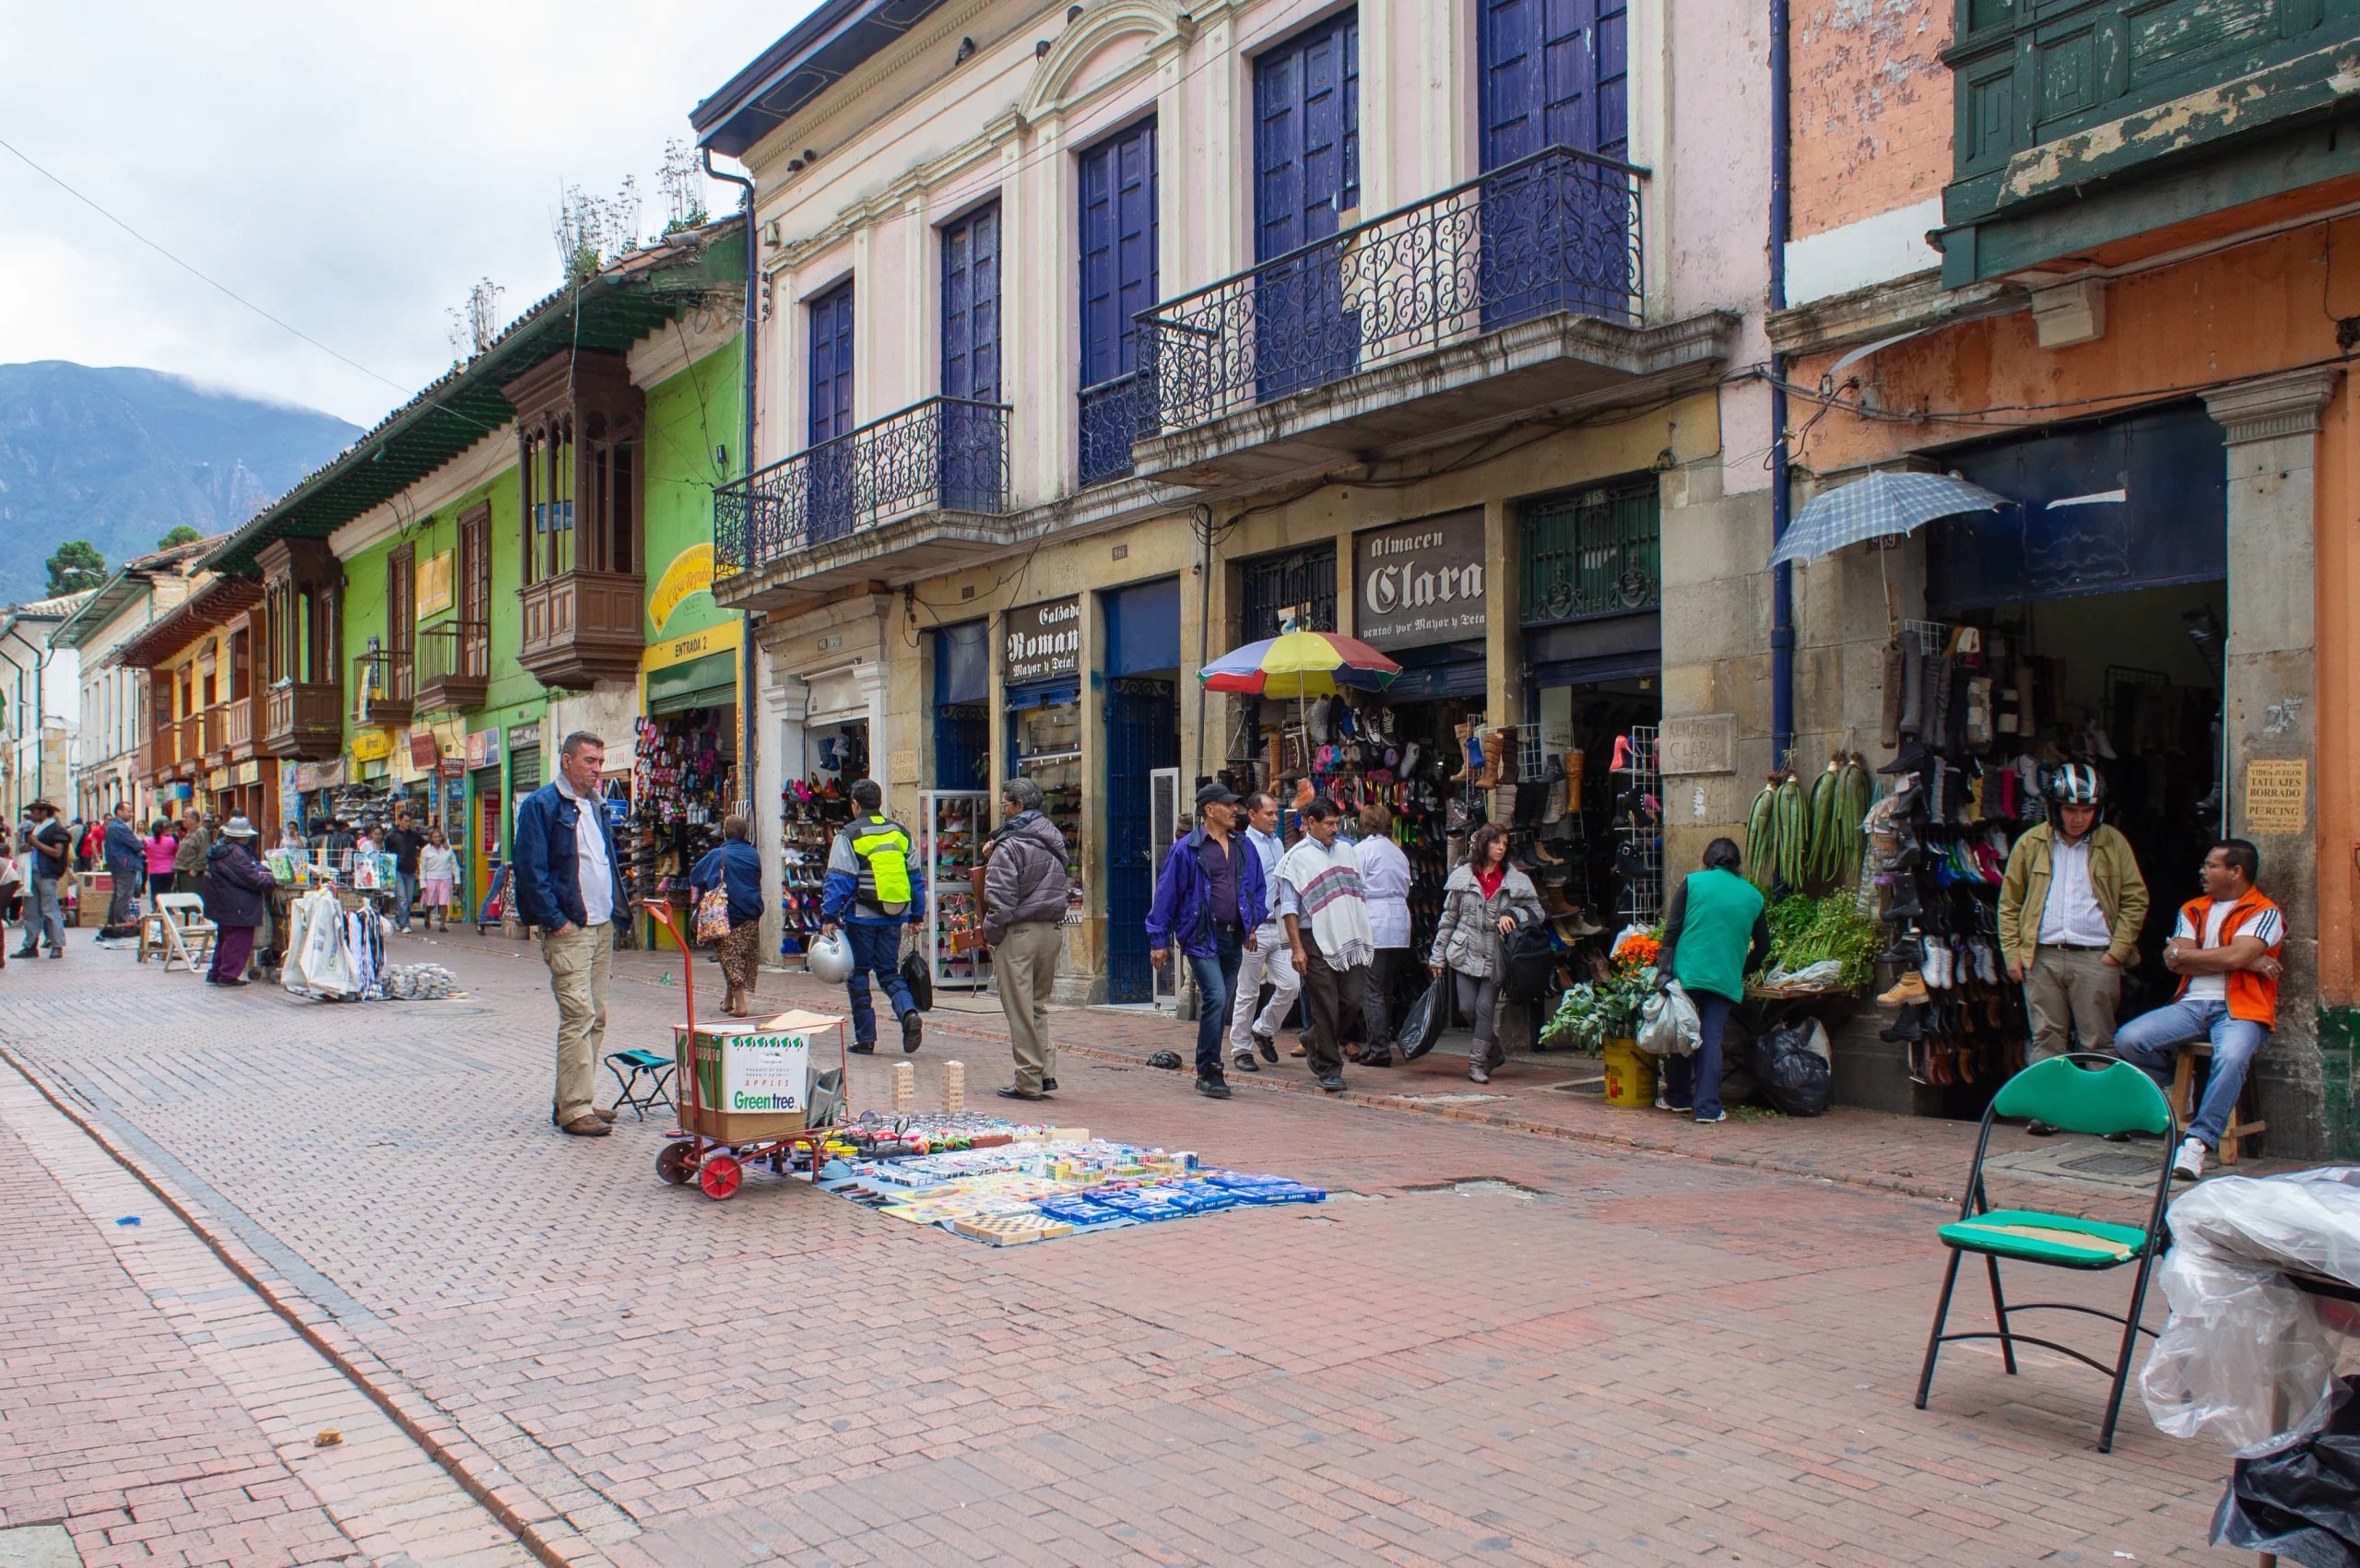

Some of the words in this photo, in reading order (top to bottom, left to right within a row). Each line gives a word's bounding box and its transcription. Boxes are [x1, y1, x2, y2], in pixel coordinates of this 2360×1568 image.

[1372, 531, 1443, 558] Almacen
[1367, 560, 1485, 614] Clara
[1396, 623, 1411, 636] por
[1414, 618, 1449, 632] Mayor
[1451, 617, 1457, 629] y
[1460, 614, 1485, 626] Deta
[675, 638, 701, 657] ENTRADA
[702, 636, 707, 650] 2
[1013, 663, 1042, 678] Mayor
[1044, 660, 1049, 673] y
[1051, 654, 1075, 670] Detal
[1669, 723, 1718, 738] ALMACEN
[1670, 740, 1714, 760] CLARA
[2249, 778, 2301, 787] TATUAJES
[2249, 788, 2301, 797] BORRADO
[2248, 807, 2299, 817] PIERCING
[745, 1079, 789, 1087] APPLES
